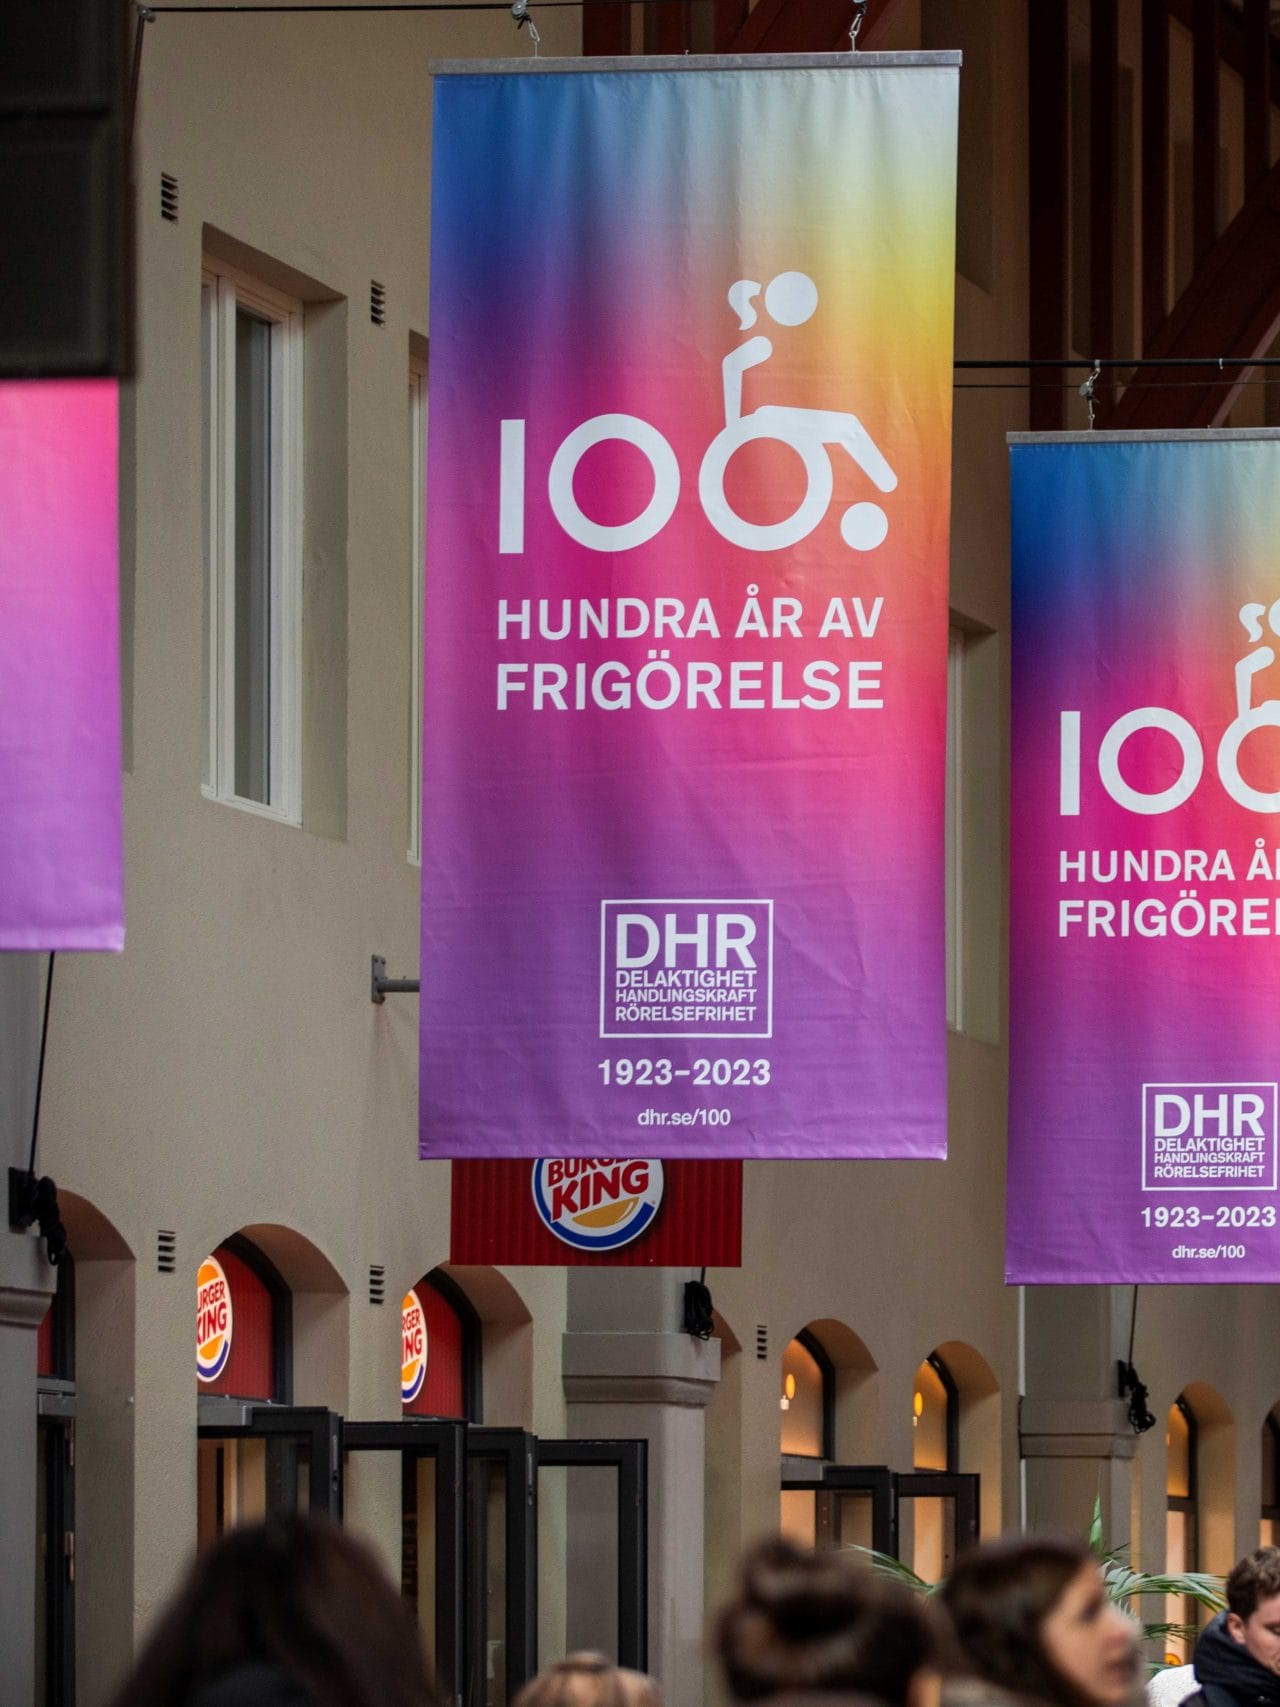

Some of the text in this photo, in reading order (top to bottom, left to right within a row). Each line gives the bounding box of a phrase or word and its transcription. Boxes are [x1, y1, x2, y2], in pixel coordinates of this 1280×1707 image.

[499, 413, 833, 553] 100
[498, 584, 884, 640] HUNDRA ÅR AV
[497, 649, 884, 710] FRIGÖRELSE
[1060, 849, 1235, 882] HUNDRA
[616, 914, 757, 968] DHR
[616, 970, 757, 988] DELAKTIGHET
[615, 989, 757, 1002] HANDLINGSKRAFT
[615, 1003, 757, 1021] RÖRELSEFRIHET
[638, 1109, 731, 1126] dhr.se/100
[1154, 1094, 1265, 1137] DHR
[1154, 1137, 1265, 1152] DELAKTIGHET
[1154, 1152, 1265, 1163] HANDLINGSKRAFT
[1154, 1164, 1265, 1178] RÖRELSEFRIHET
[551, 1160, 649, 1222] KING
[1172, 1245, 1245, 1259] dhr.se/100
